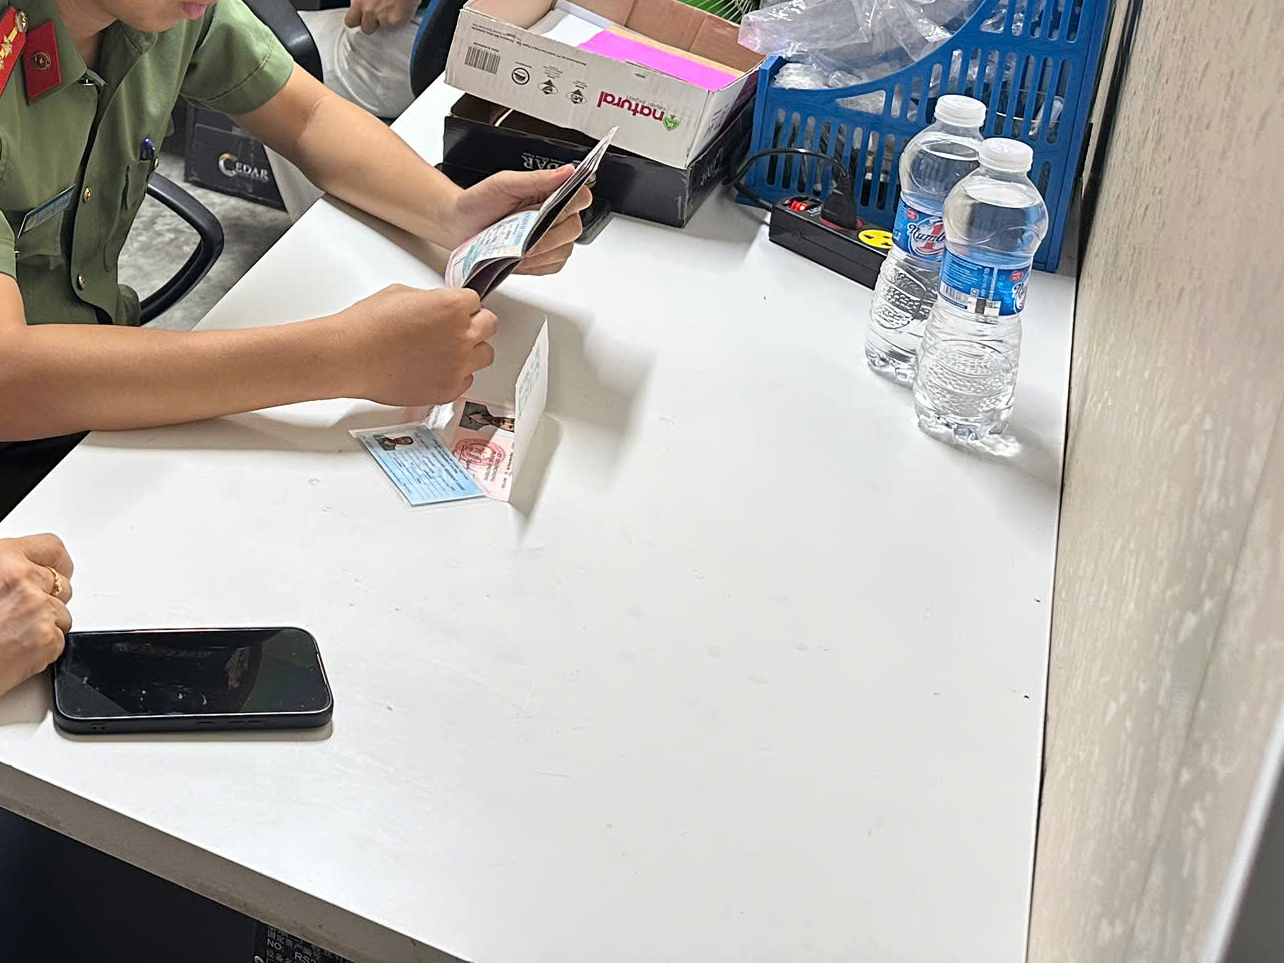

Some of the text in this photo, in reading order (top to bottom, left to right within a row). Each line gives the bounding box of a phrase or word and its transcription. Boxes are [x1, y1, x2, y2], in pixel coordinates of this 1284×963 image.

[597, 90, 665, 122] natural
[218, 152, 269, 181] CEDAR
[908, 223, 946, 243] Numb
